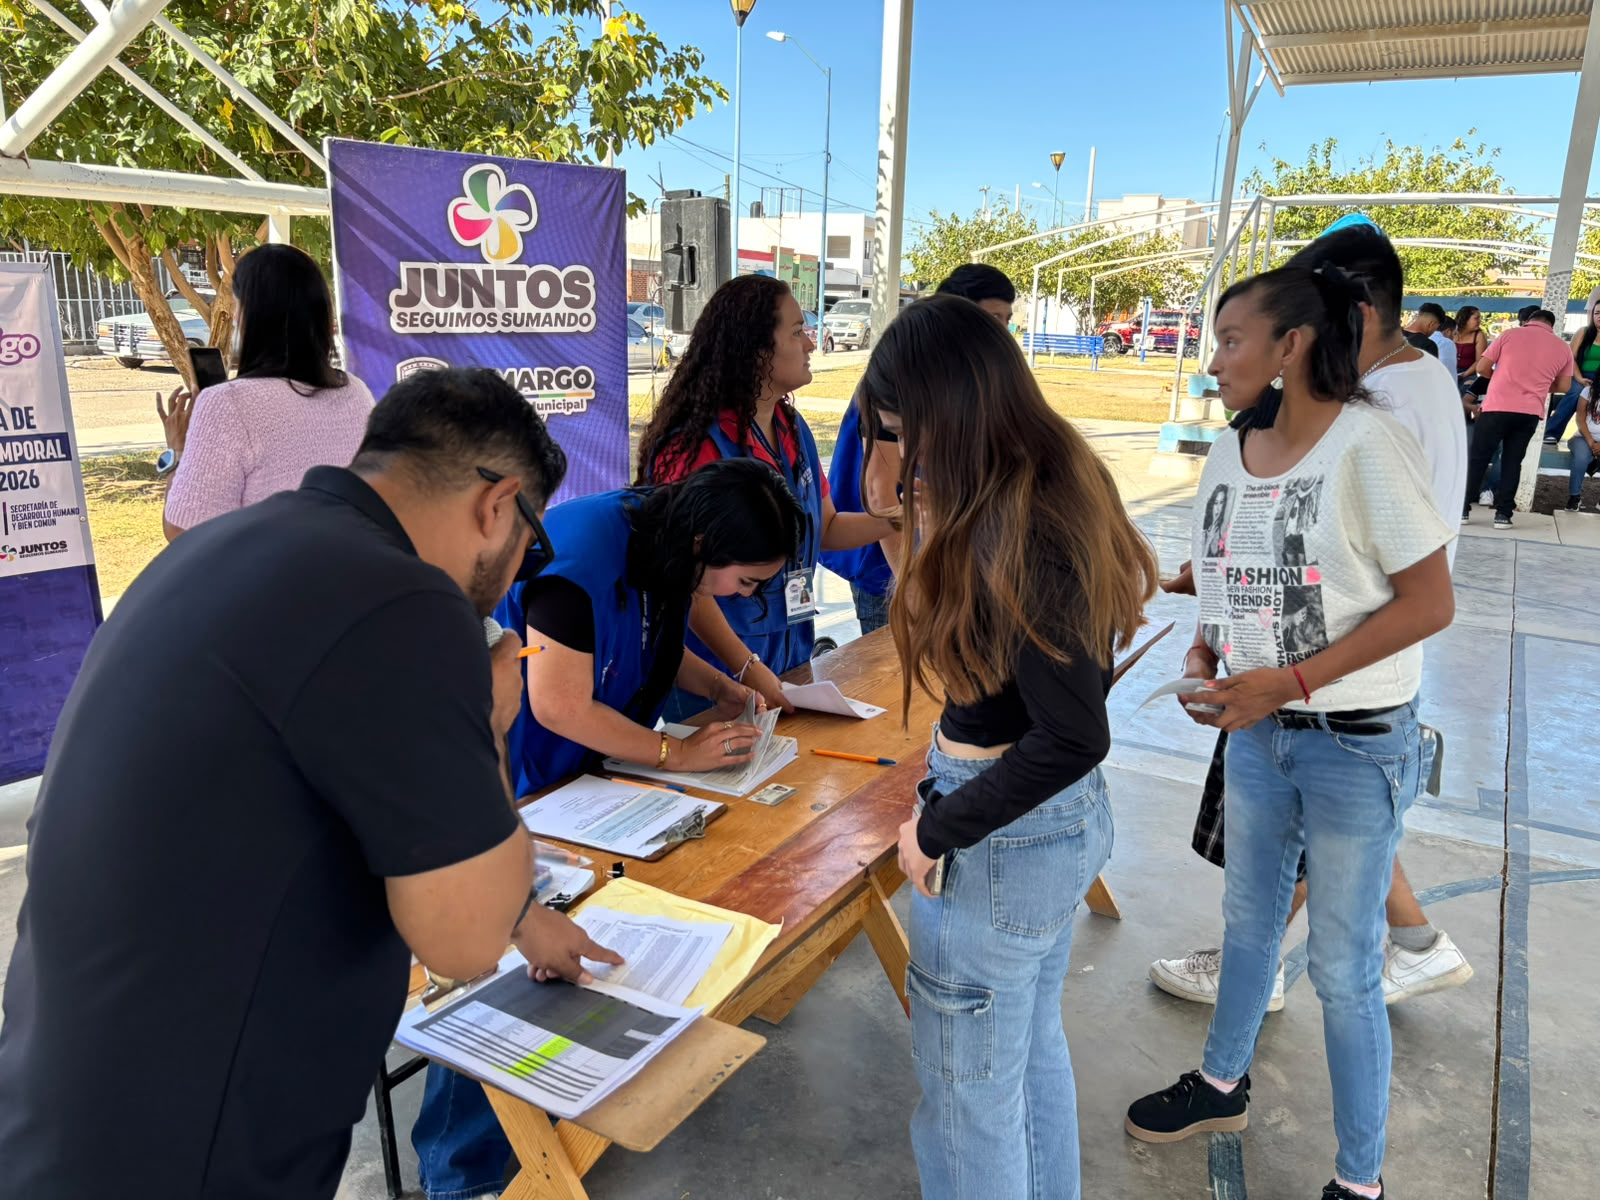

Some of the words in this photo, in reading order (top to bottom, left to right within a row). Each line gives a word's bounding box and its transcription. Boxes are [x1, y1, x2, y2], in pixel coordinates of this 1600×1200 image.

[394, 267, 591, 309] JUNTOS
[396, 312, 498, 327] SEGUIMOS
[501, 312, 592, 327] SUMANDO
[533, 399, 584, 412] unicipal
[11, 406, 37, 431] DE
[0, 469, 40, 491] 2026
[10, 501, 48, 513] SECRETARÍA
[11, 510, 51, 522] DESARROLLO
[53, 507, 80, 517] HUMANO
[12, 522, 17, 531] Y
[18, 521, 33, 530] BIEN
[19, 540, 68, 554] JUNTOS
[1226, 567, 1302, 585] FASHION
[1242, 586, 1273, 594] FASHION
[1227, 594, 1272, 607] TRENDS
[1273, 589, 1282, 617] HOT
